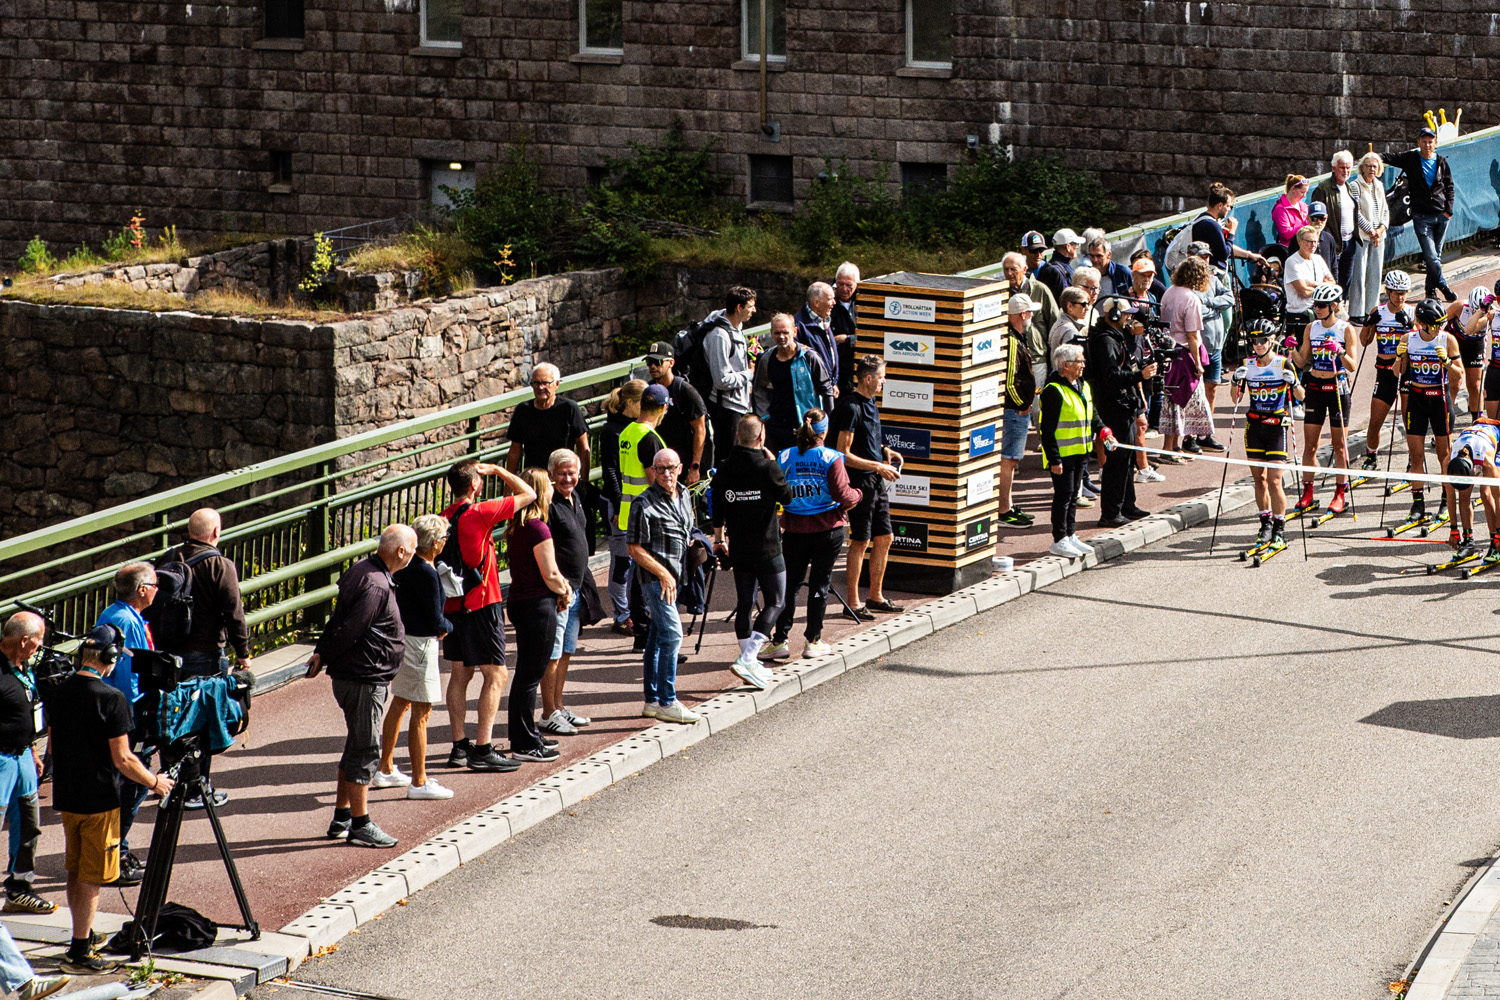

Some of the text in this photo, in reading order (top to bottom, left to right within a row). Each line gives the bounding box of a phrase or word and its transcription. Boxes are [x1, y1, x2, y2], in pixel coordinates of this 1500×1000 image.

[902, 303, 932, 311] TROLLHÄTTAN
[1380, 334, 1397, 345] 51
[888, 340, 919, 352] GKN
[1412, 362, 1440, 375] 509
[1251, 388, 1279, 401] 505
[793, 484, 822, 499] JURY
[895, 483, 917, 491] ROLLER
[892, 536, 922, 544] ERTINA
[968, 532, 988, 544] CERTINA
